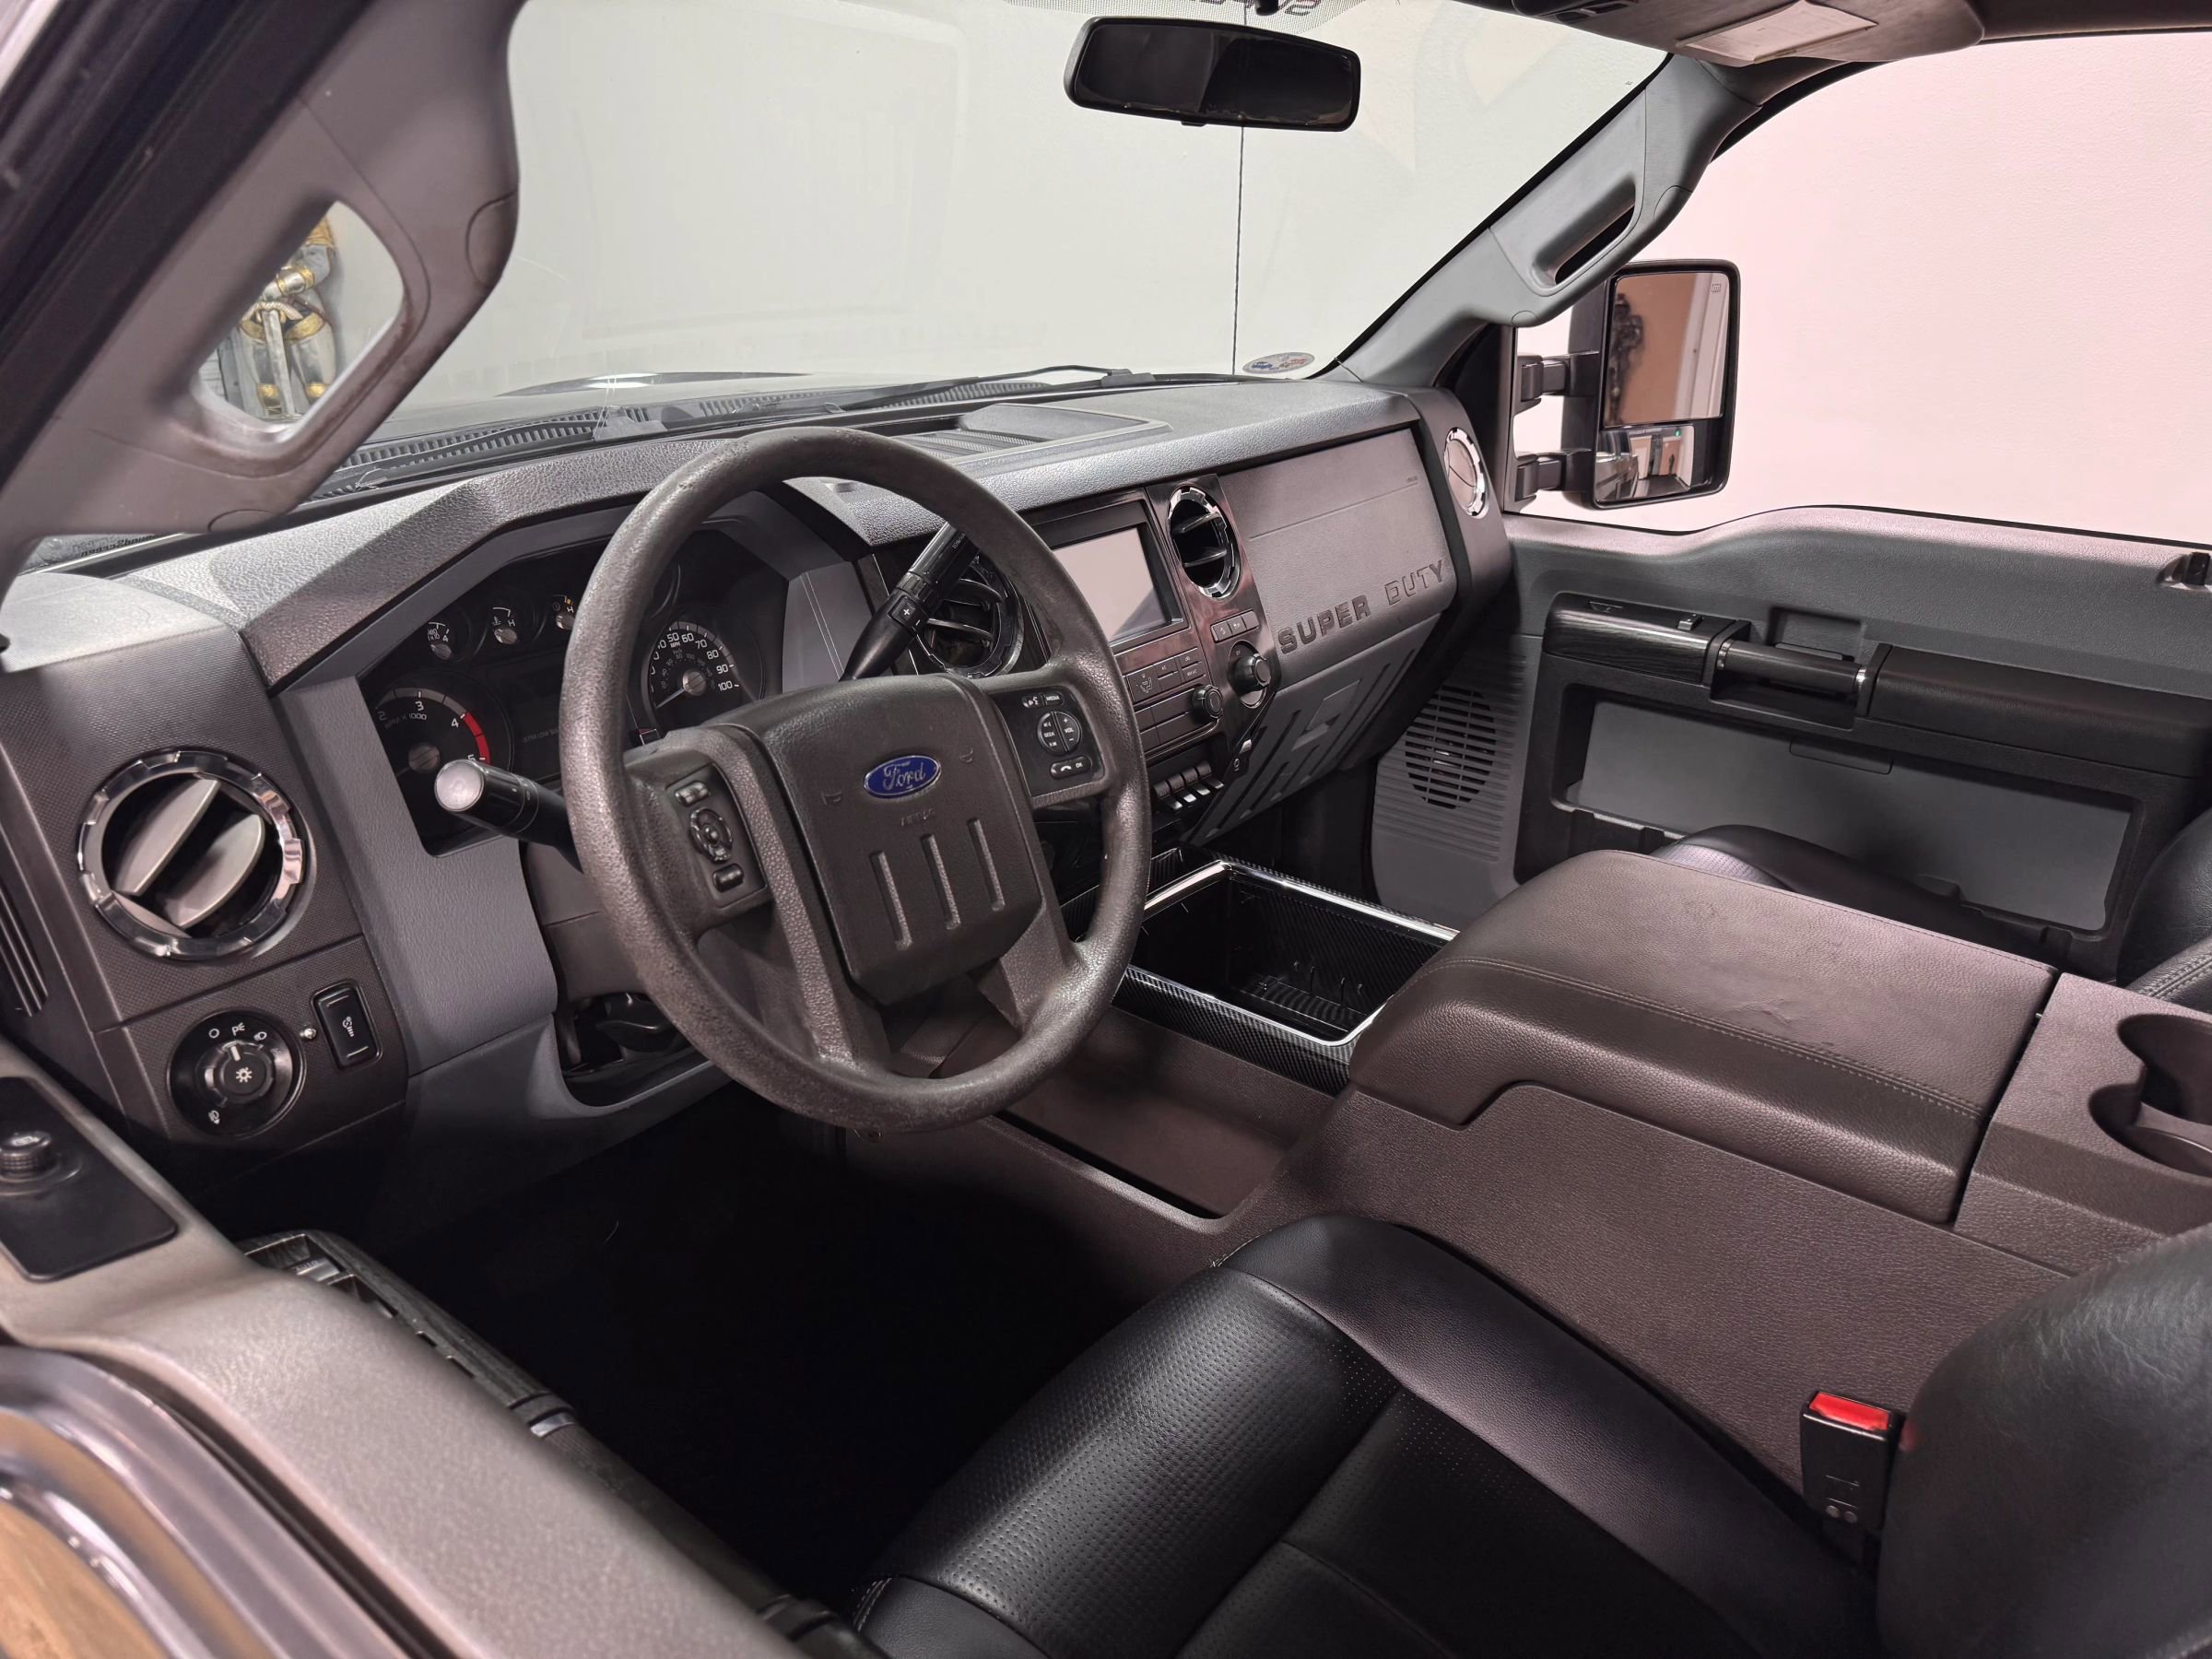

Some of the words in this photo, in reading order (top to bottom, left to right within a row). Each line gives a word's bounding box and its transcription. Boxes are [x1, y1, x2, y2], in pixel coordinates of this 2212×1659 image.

[1277, 594, 1372, 655] SUPER
[1384, 559, 1443, 606] DUTY
[666, 632, 679, 642] 50
[681, 632, 695, 643] 60
[657, 640, 667, 650] 0
[695, 639, 708, 649] 70
[706, 649, 719, 660] 80
[716, 664, 729, 675] 90
[718, 680, 733, 691] 100
[415, 700, 424, 711] 3
[451, 718, 459, 728] 4
[883, 760, 926, 791] Ford
